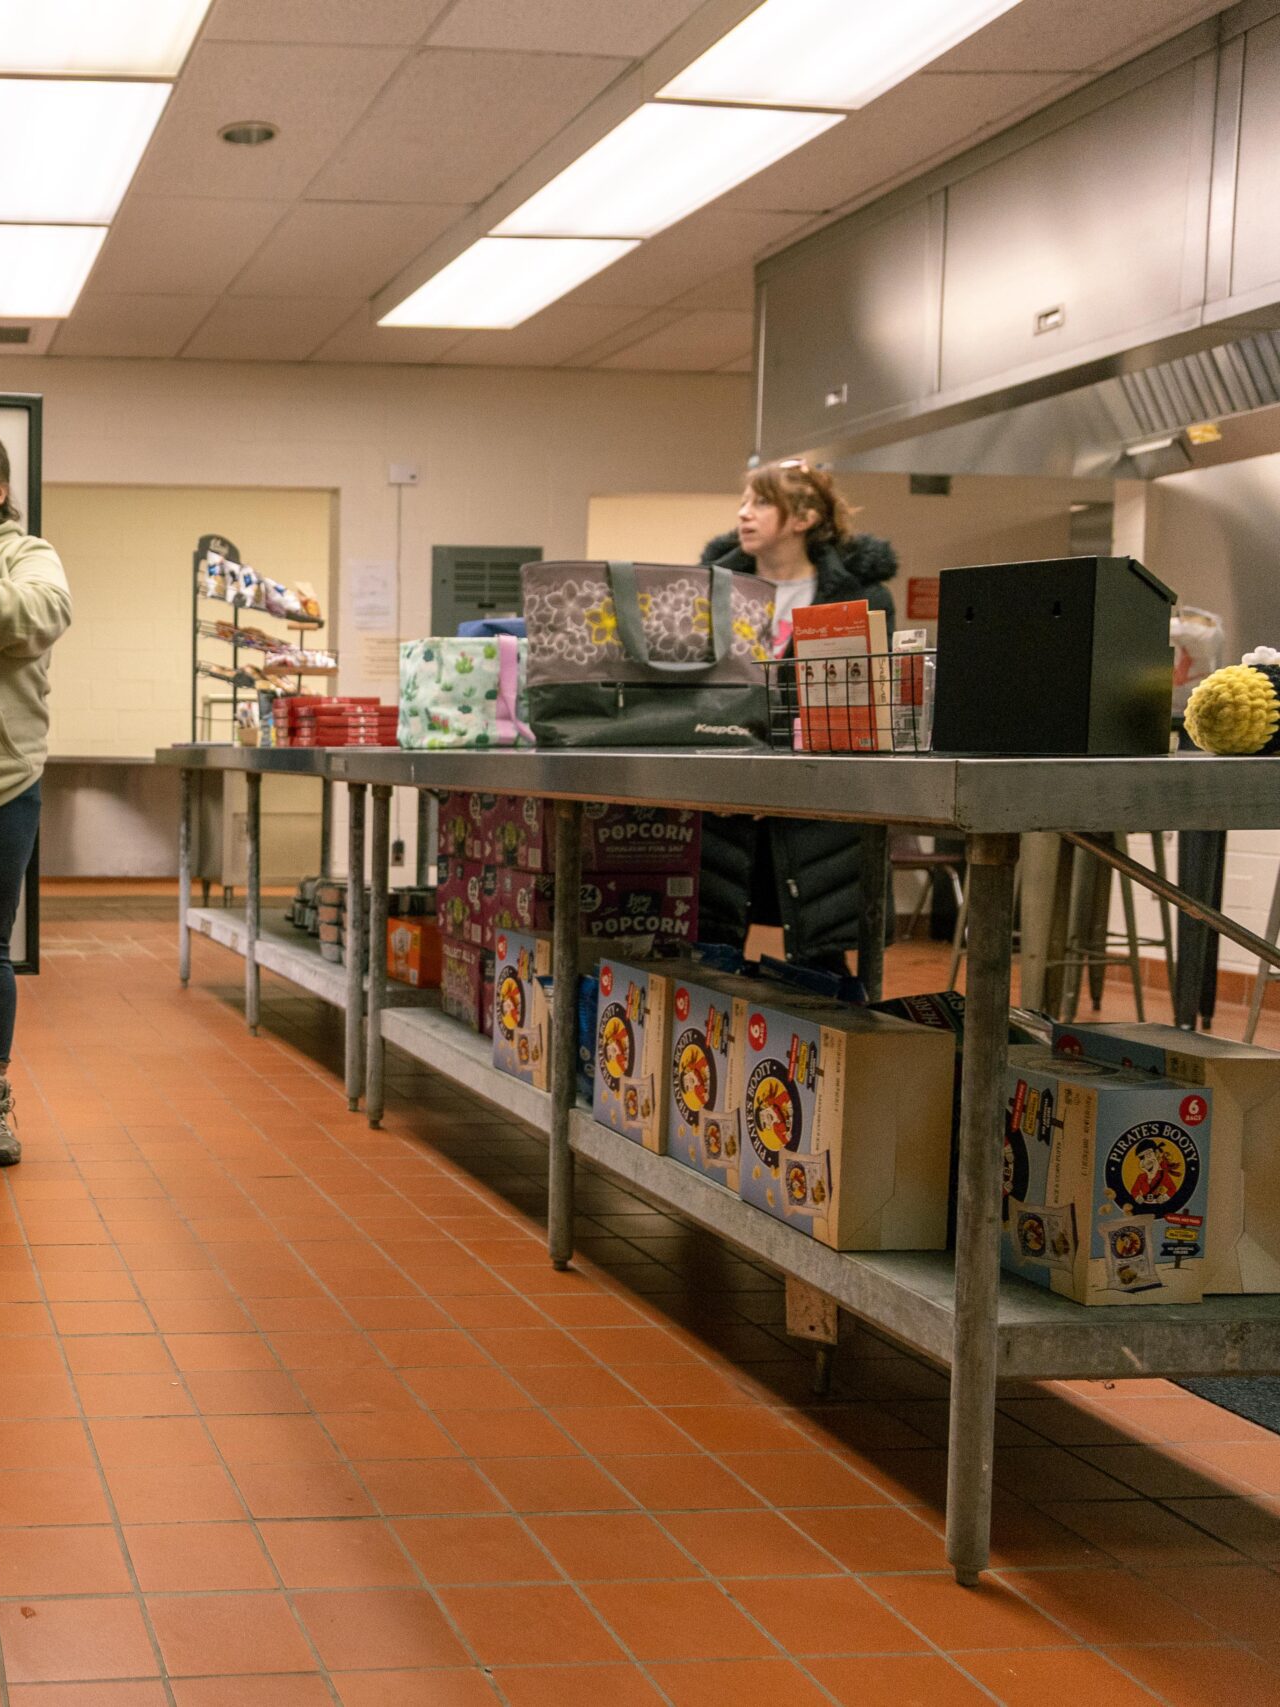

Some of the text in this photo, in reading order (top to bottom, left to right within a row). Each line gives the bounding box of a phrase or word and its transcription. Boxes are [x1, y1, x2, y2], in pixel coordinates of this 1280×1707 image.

[598, 821, 695, 844] POPCORN
[580, 887, 597, 901] 24
[591, 916, 691, 937] POPCORN
[675, 997, 685, 1010] 6
[750, 1024, 760, 1039] 6
[673, 1030, 694, 1119] PIRATE'S BOOTY
[746, 1060, 771, 1159] PIRATE'S BOOTY
[1188, 1099, 1200, 1115] 6
[1109, 1123, 1160, 1163] PIRATE'S
[1162, 1124, 1198, 1162] BOOTY
